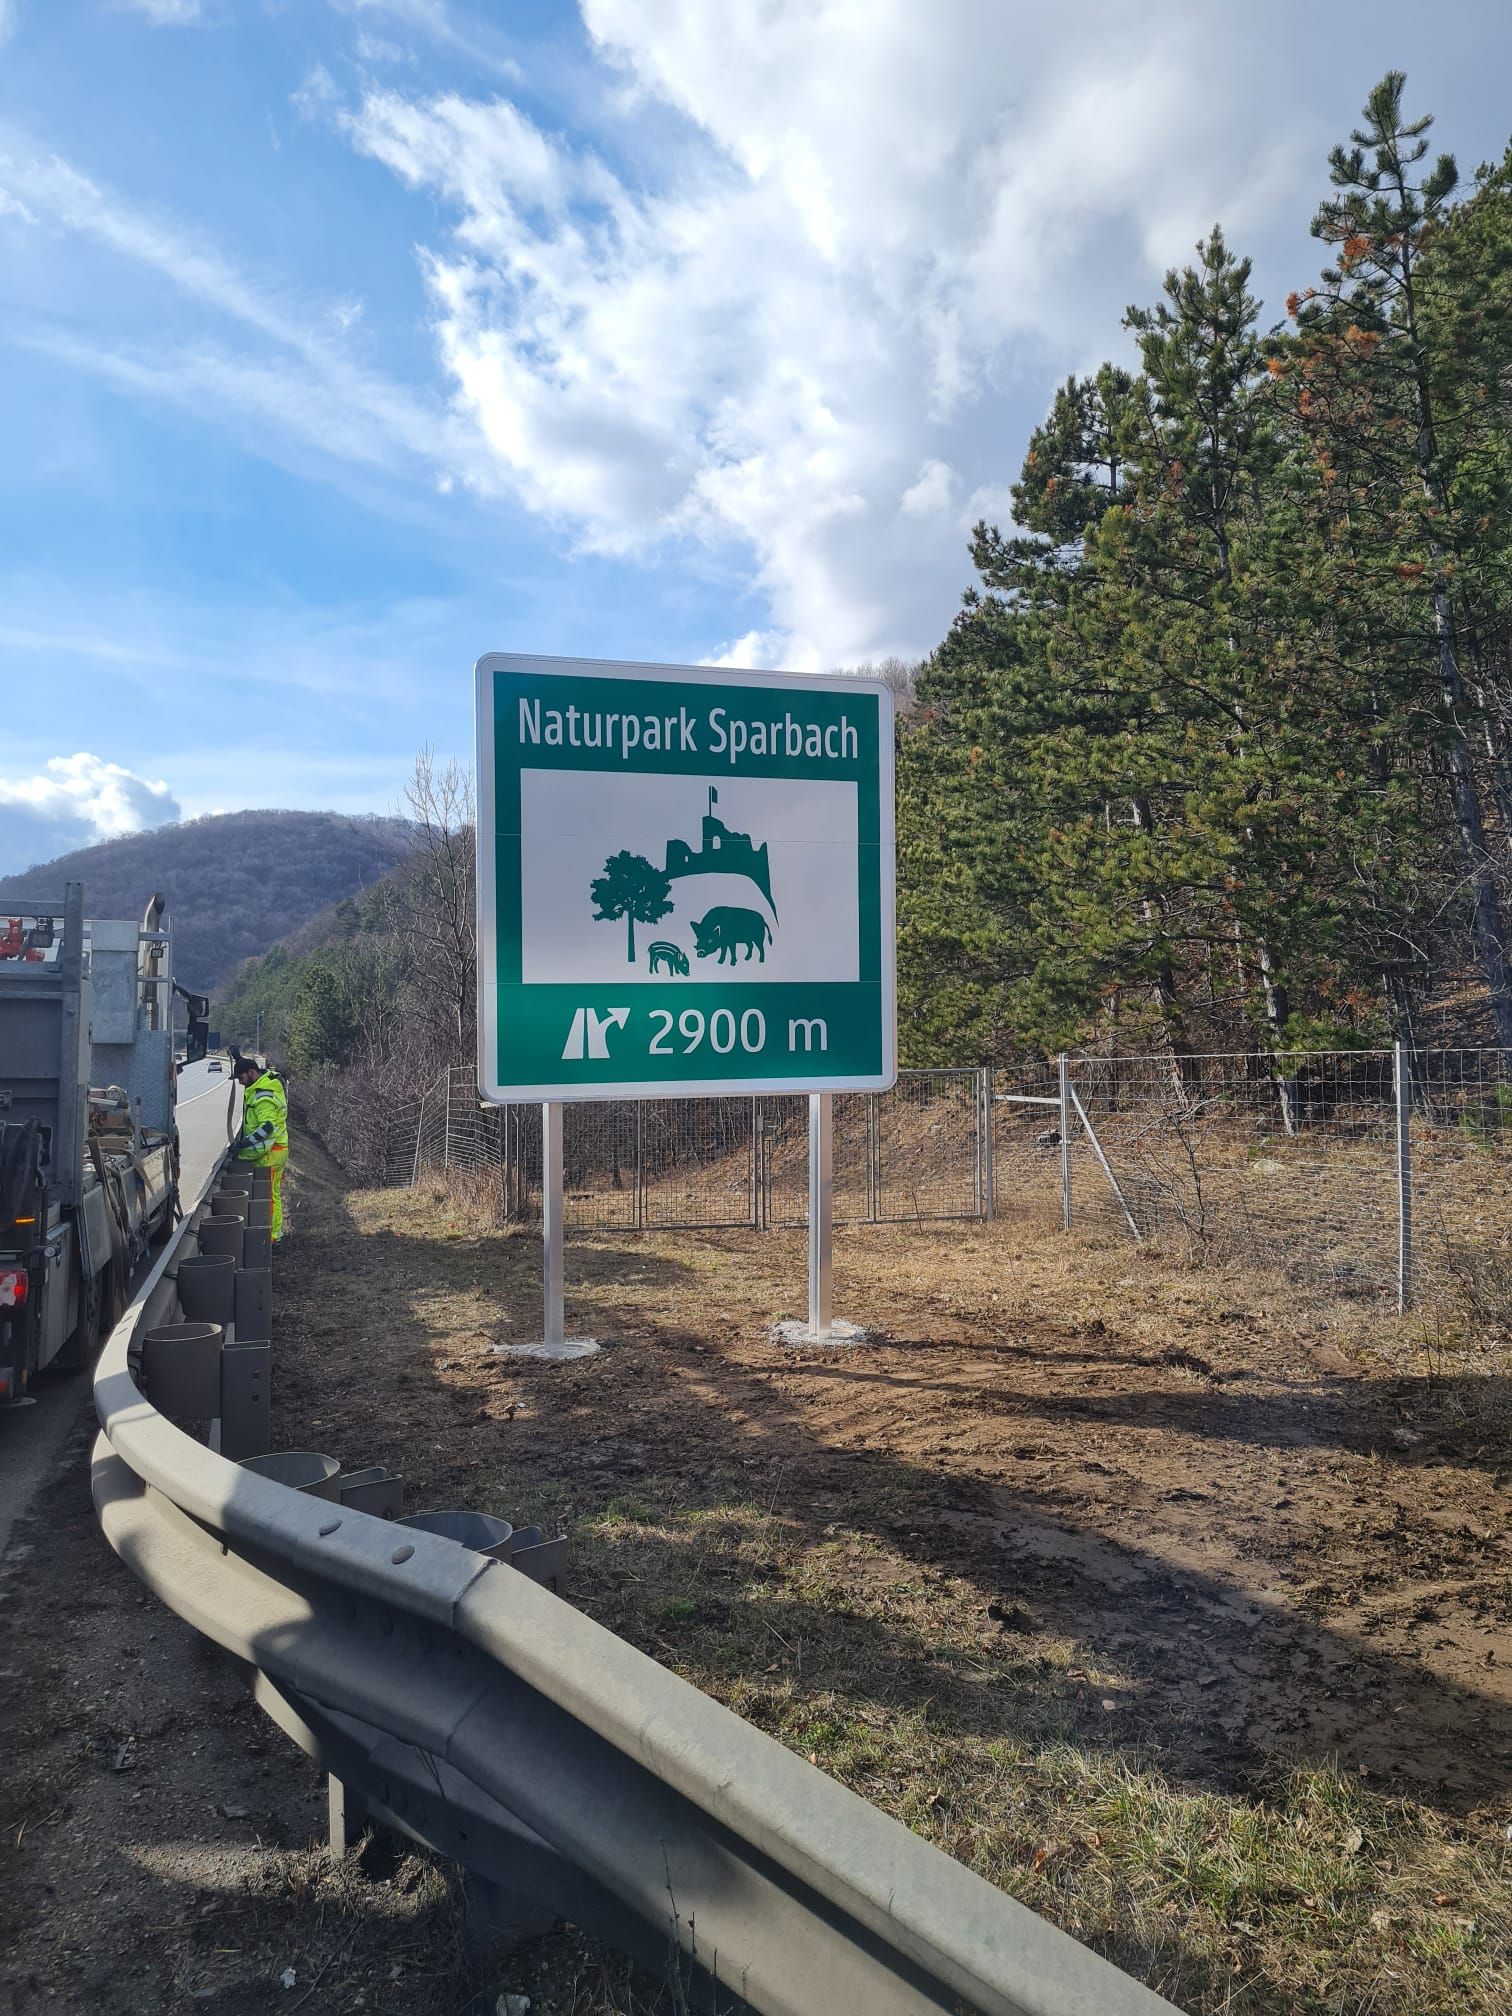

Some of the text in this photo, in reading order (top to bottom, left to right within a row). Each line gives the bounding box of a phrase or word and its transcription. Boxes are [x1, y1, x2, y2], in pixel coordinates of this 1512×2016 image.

[519, 697, 859, 764] Naturpark Sparbach
[648, 1008, 828, 1055] 2900 m
